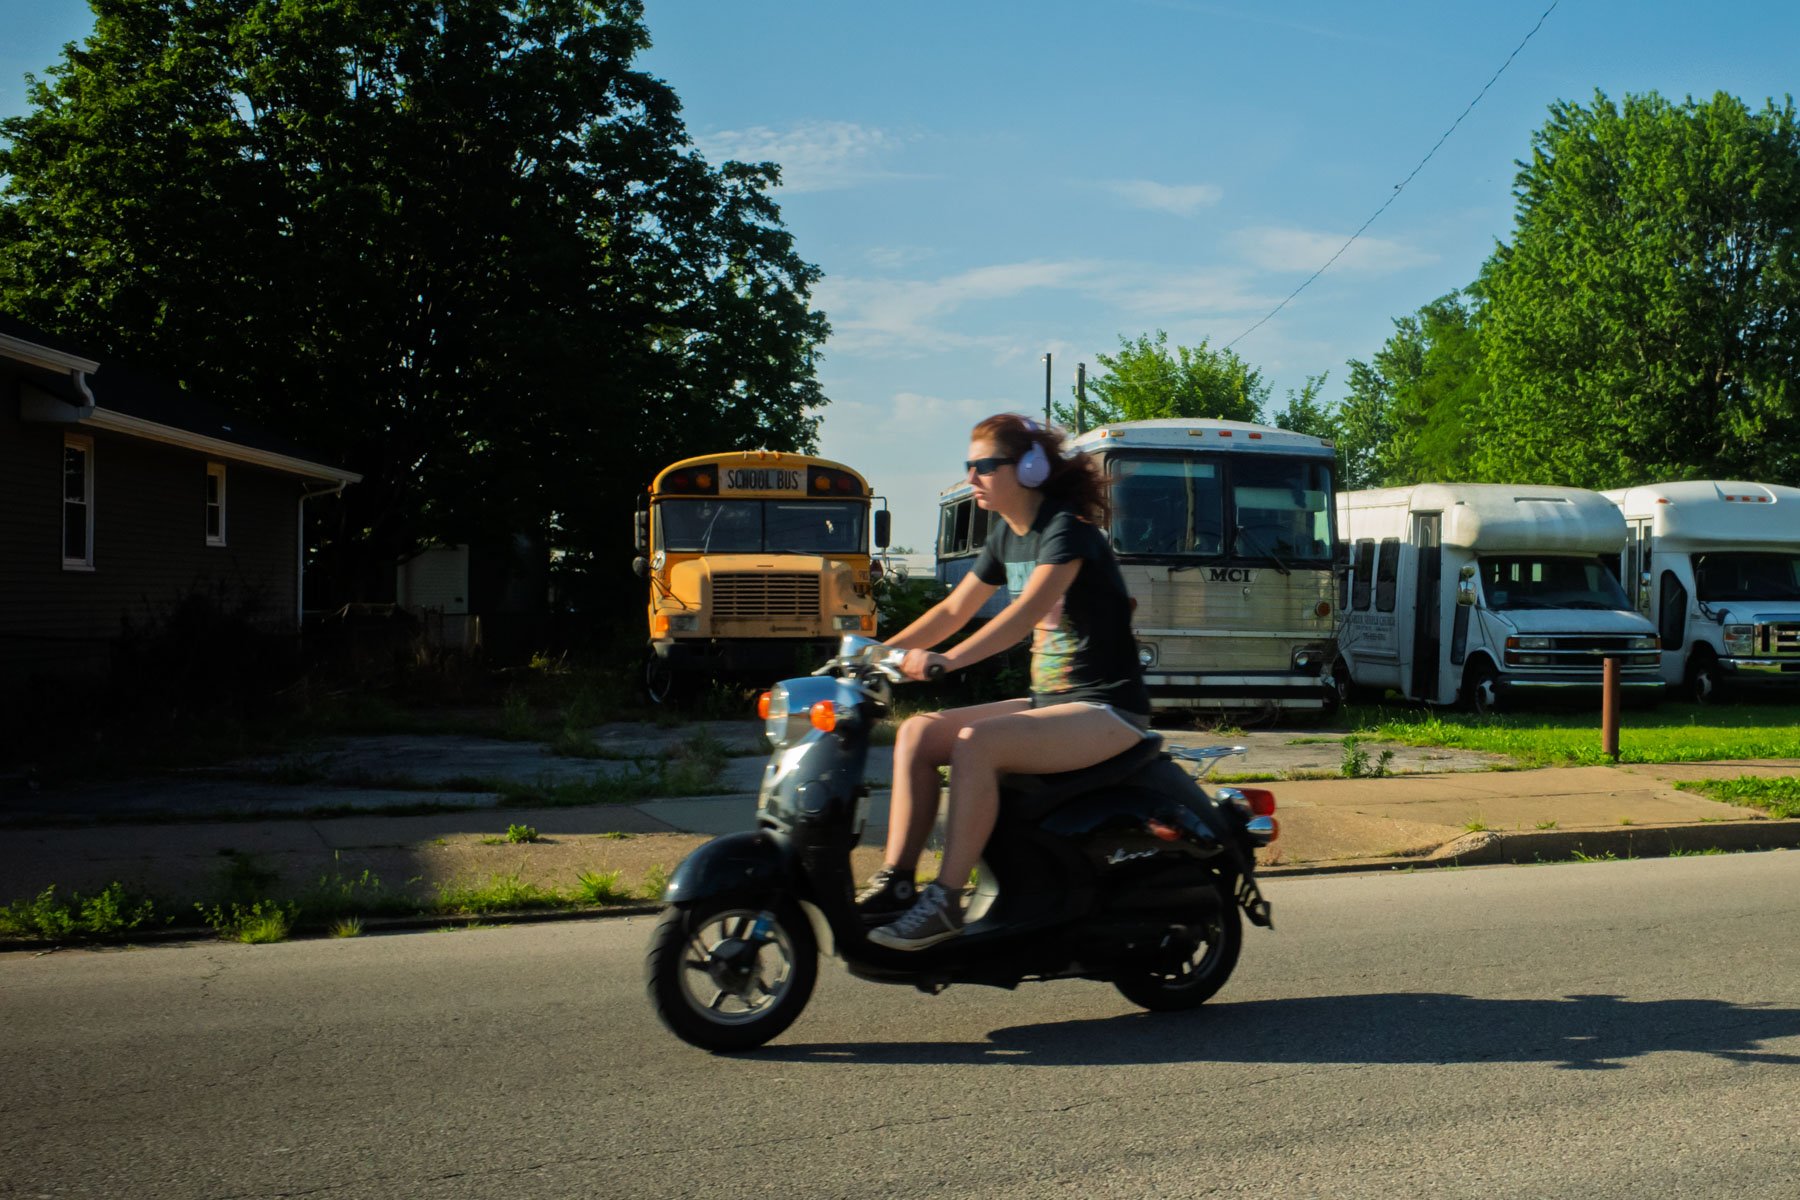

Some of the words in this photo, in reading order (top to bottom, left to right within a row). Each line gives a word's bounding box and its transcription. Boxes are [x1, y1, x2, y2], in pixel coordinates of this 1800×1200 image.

[727, 469, 772, 489] SCHOOL
[777, 470, 798, 489] BUS
[1209, 568, 1251, 583] MCI
